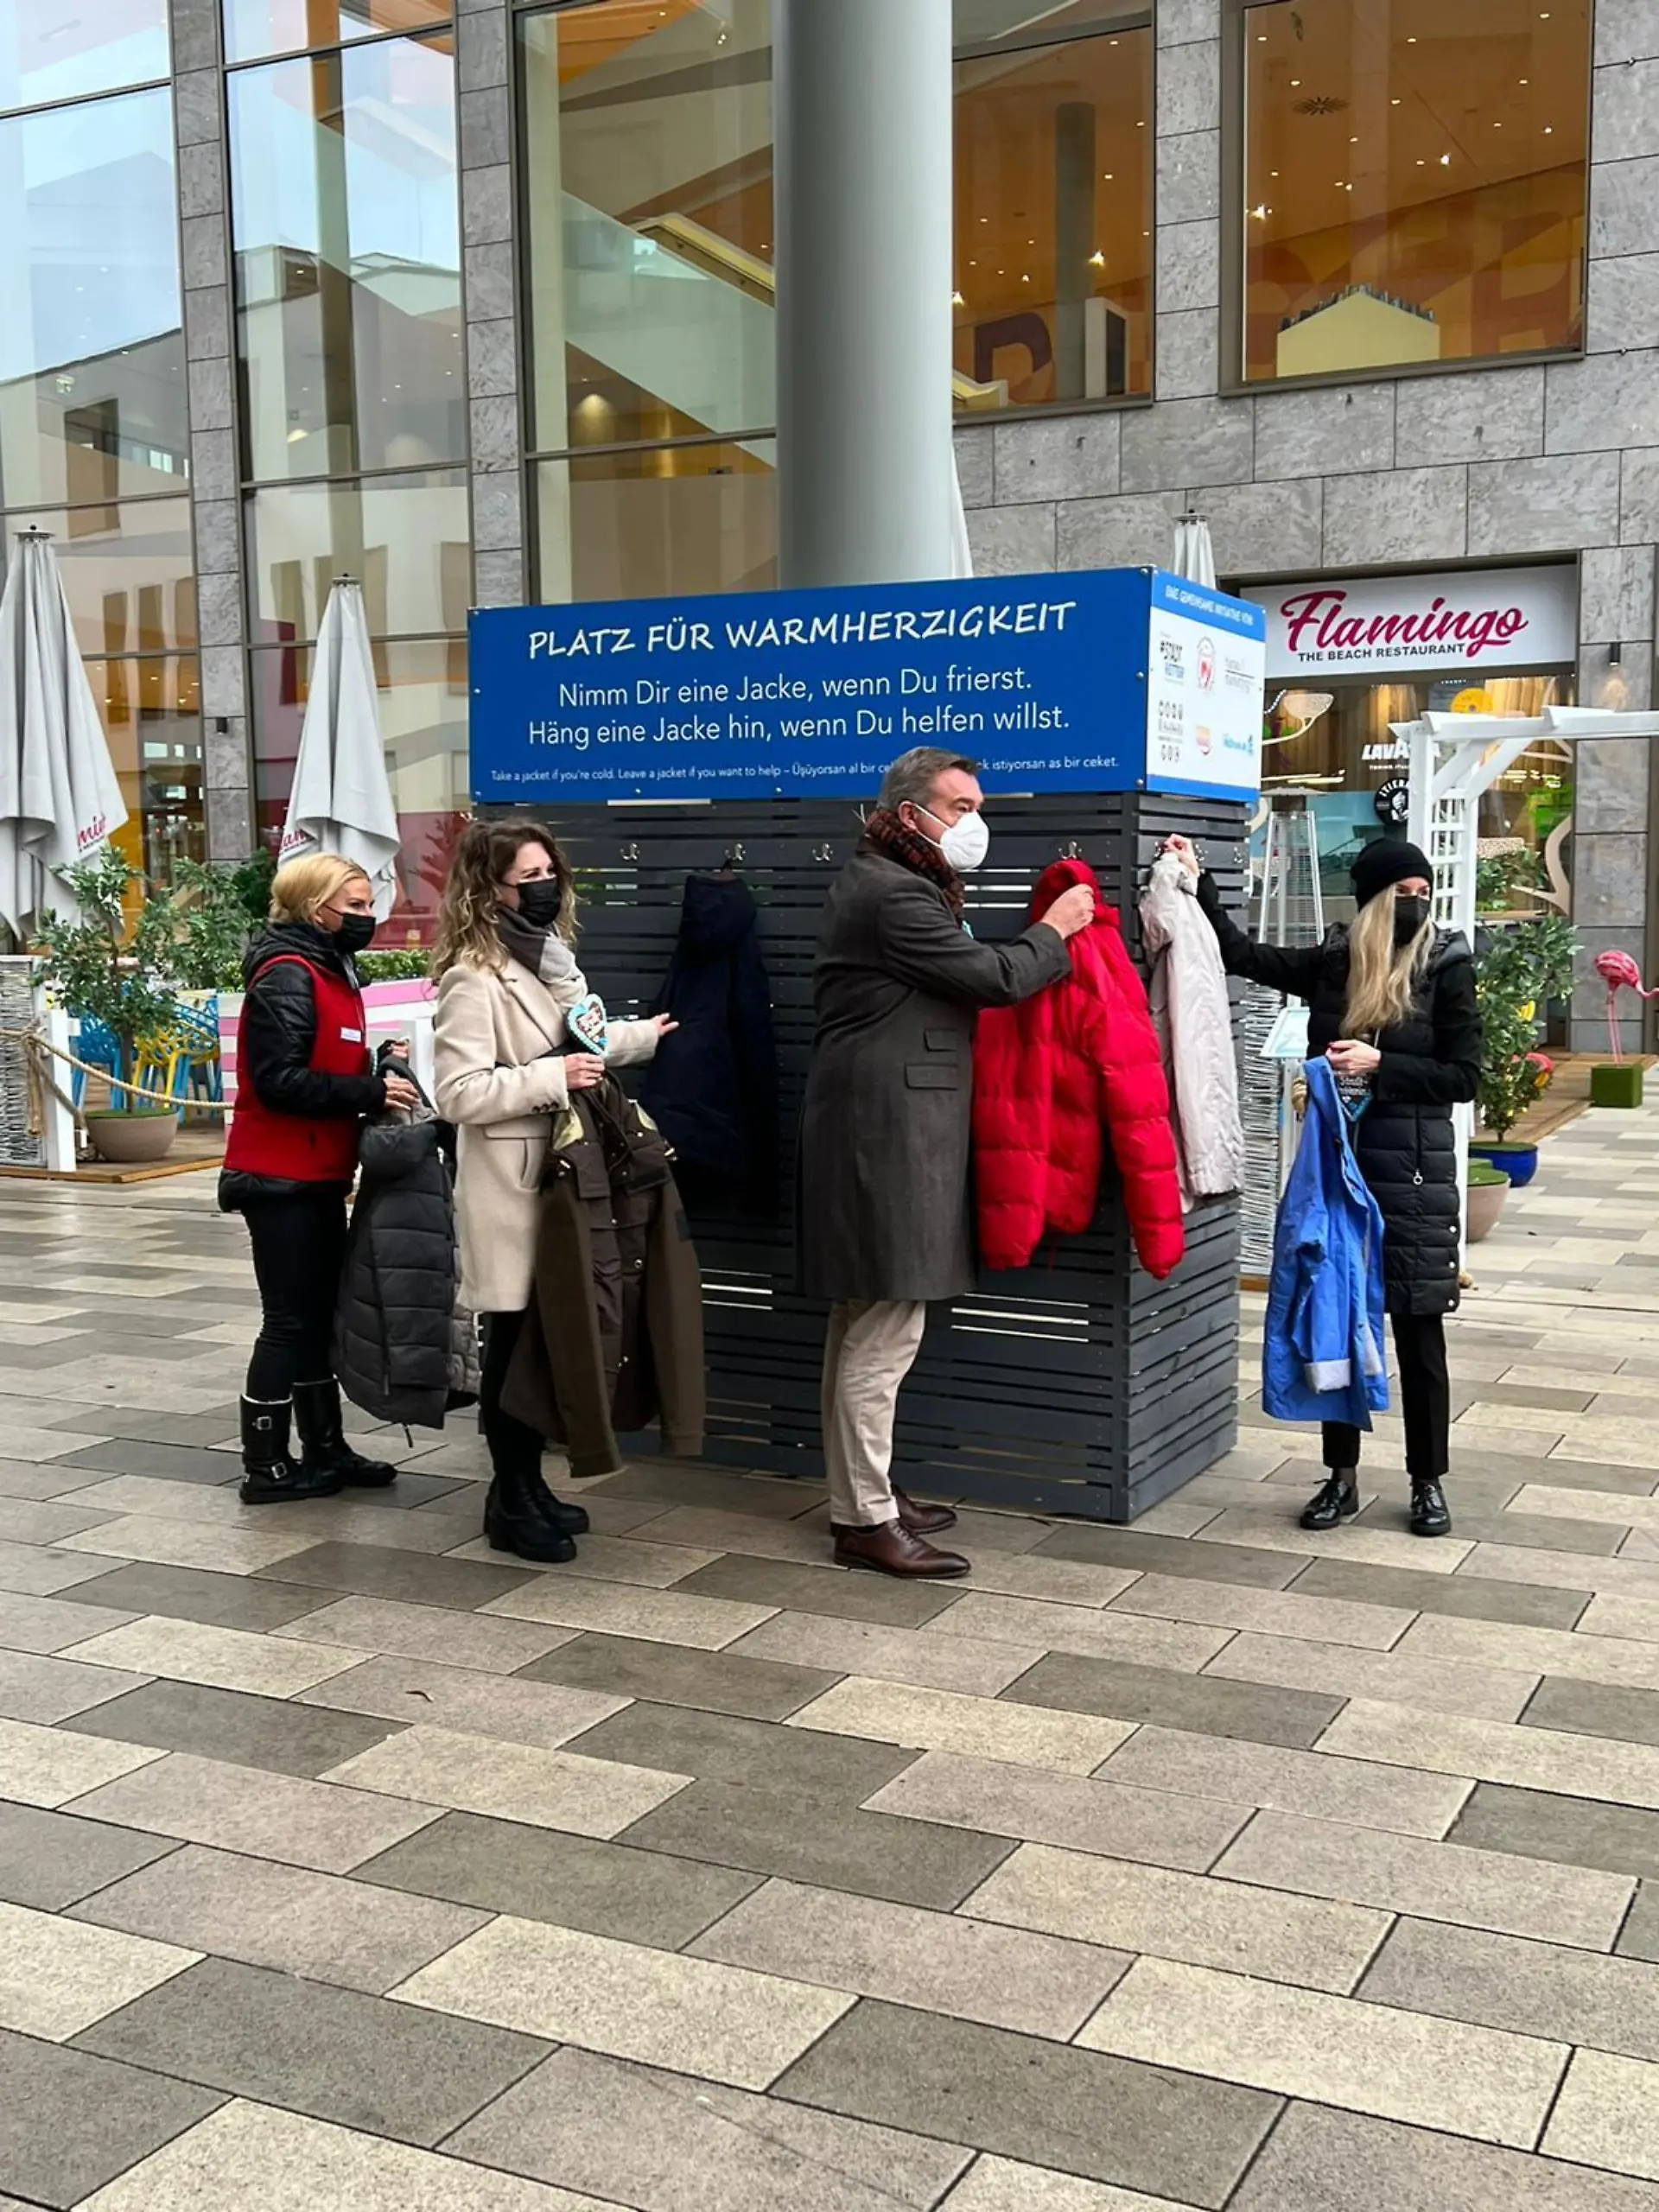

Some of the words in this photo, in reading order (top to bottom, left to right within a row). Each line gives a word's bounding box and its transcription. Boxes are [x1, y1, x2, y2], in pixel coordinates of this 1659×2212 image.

[529, 628, 635, 659] PLATZ
[648, 616, 714, 652] FÜR
[725, 601, 1077, 648] WARMHERZIGKEIT
[1280, 590, 1529, 658] Flamingo
[1299, 652, 1324, 663] THE
[1328, 648, 1372, 661] BEACH
[1376, 643, 1465, 658] RESTAURANT
[560, 683, 627, 707] Nimm
[636, 680, 671, 705] Dir
[678, 678, 728, 702] eine
[736, 673, 814, 702] Jacke,
[823, 677, 890, 696] wenn
[901, 668, 937, 694] Du
[946, 664, 1032, 692] frierst.
[530, 721, 589, 751] Häng
[597, 720, 646, 742] eine
[653, 715, 720, 741] Jacke
[729, 713, 772, 741] hin,
[780, 717, 846, 737] wenn
[856, 710, 892, 734] Du
[902, 704, 984, 733] helfen
[994, 702, 1070, 730] willst.
[491, 770, 512, 781] Take
[522, 770, 550, 783] jacket
[618, 768, 646, 779] Leave
[657, 766, 687, 780] jacket
[697, 768, 716, 779] you
[718, 766, 742, 777] want
[745, 766, 756, 776] to
[758, 764, 780, 778] help
[849, 763, 858, 774] al
[861, 762, 874, 773] bir
[993, 758, 1046, 772] istiyorsan
[1048, 760, 1062, 769] as
[1064, 755, 1080, 768] bir
[1083, 755, 1120, 768] ceket.
